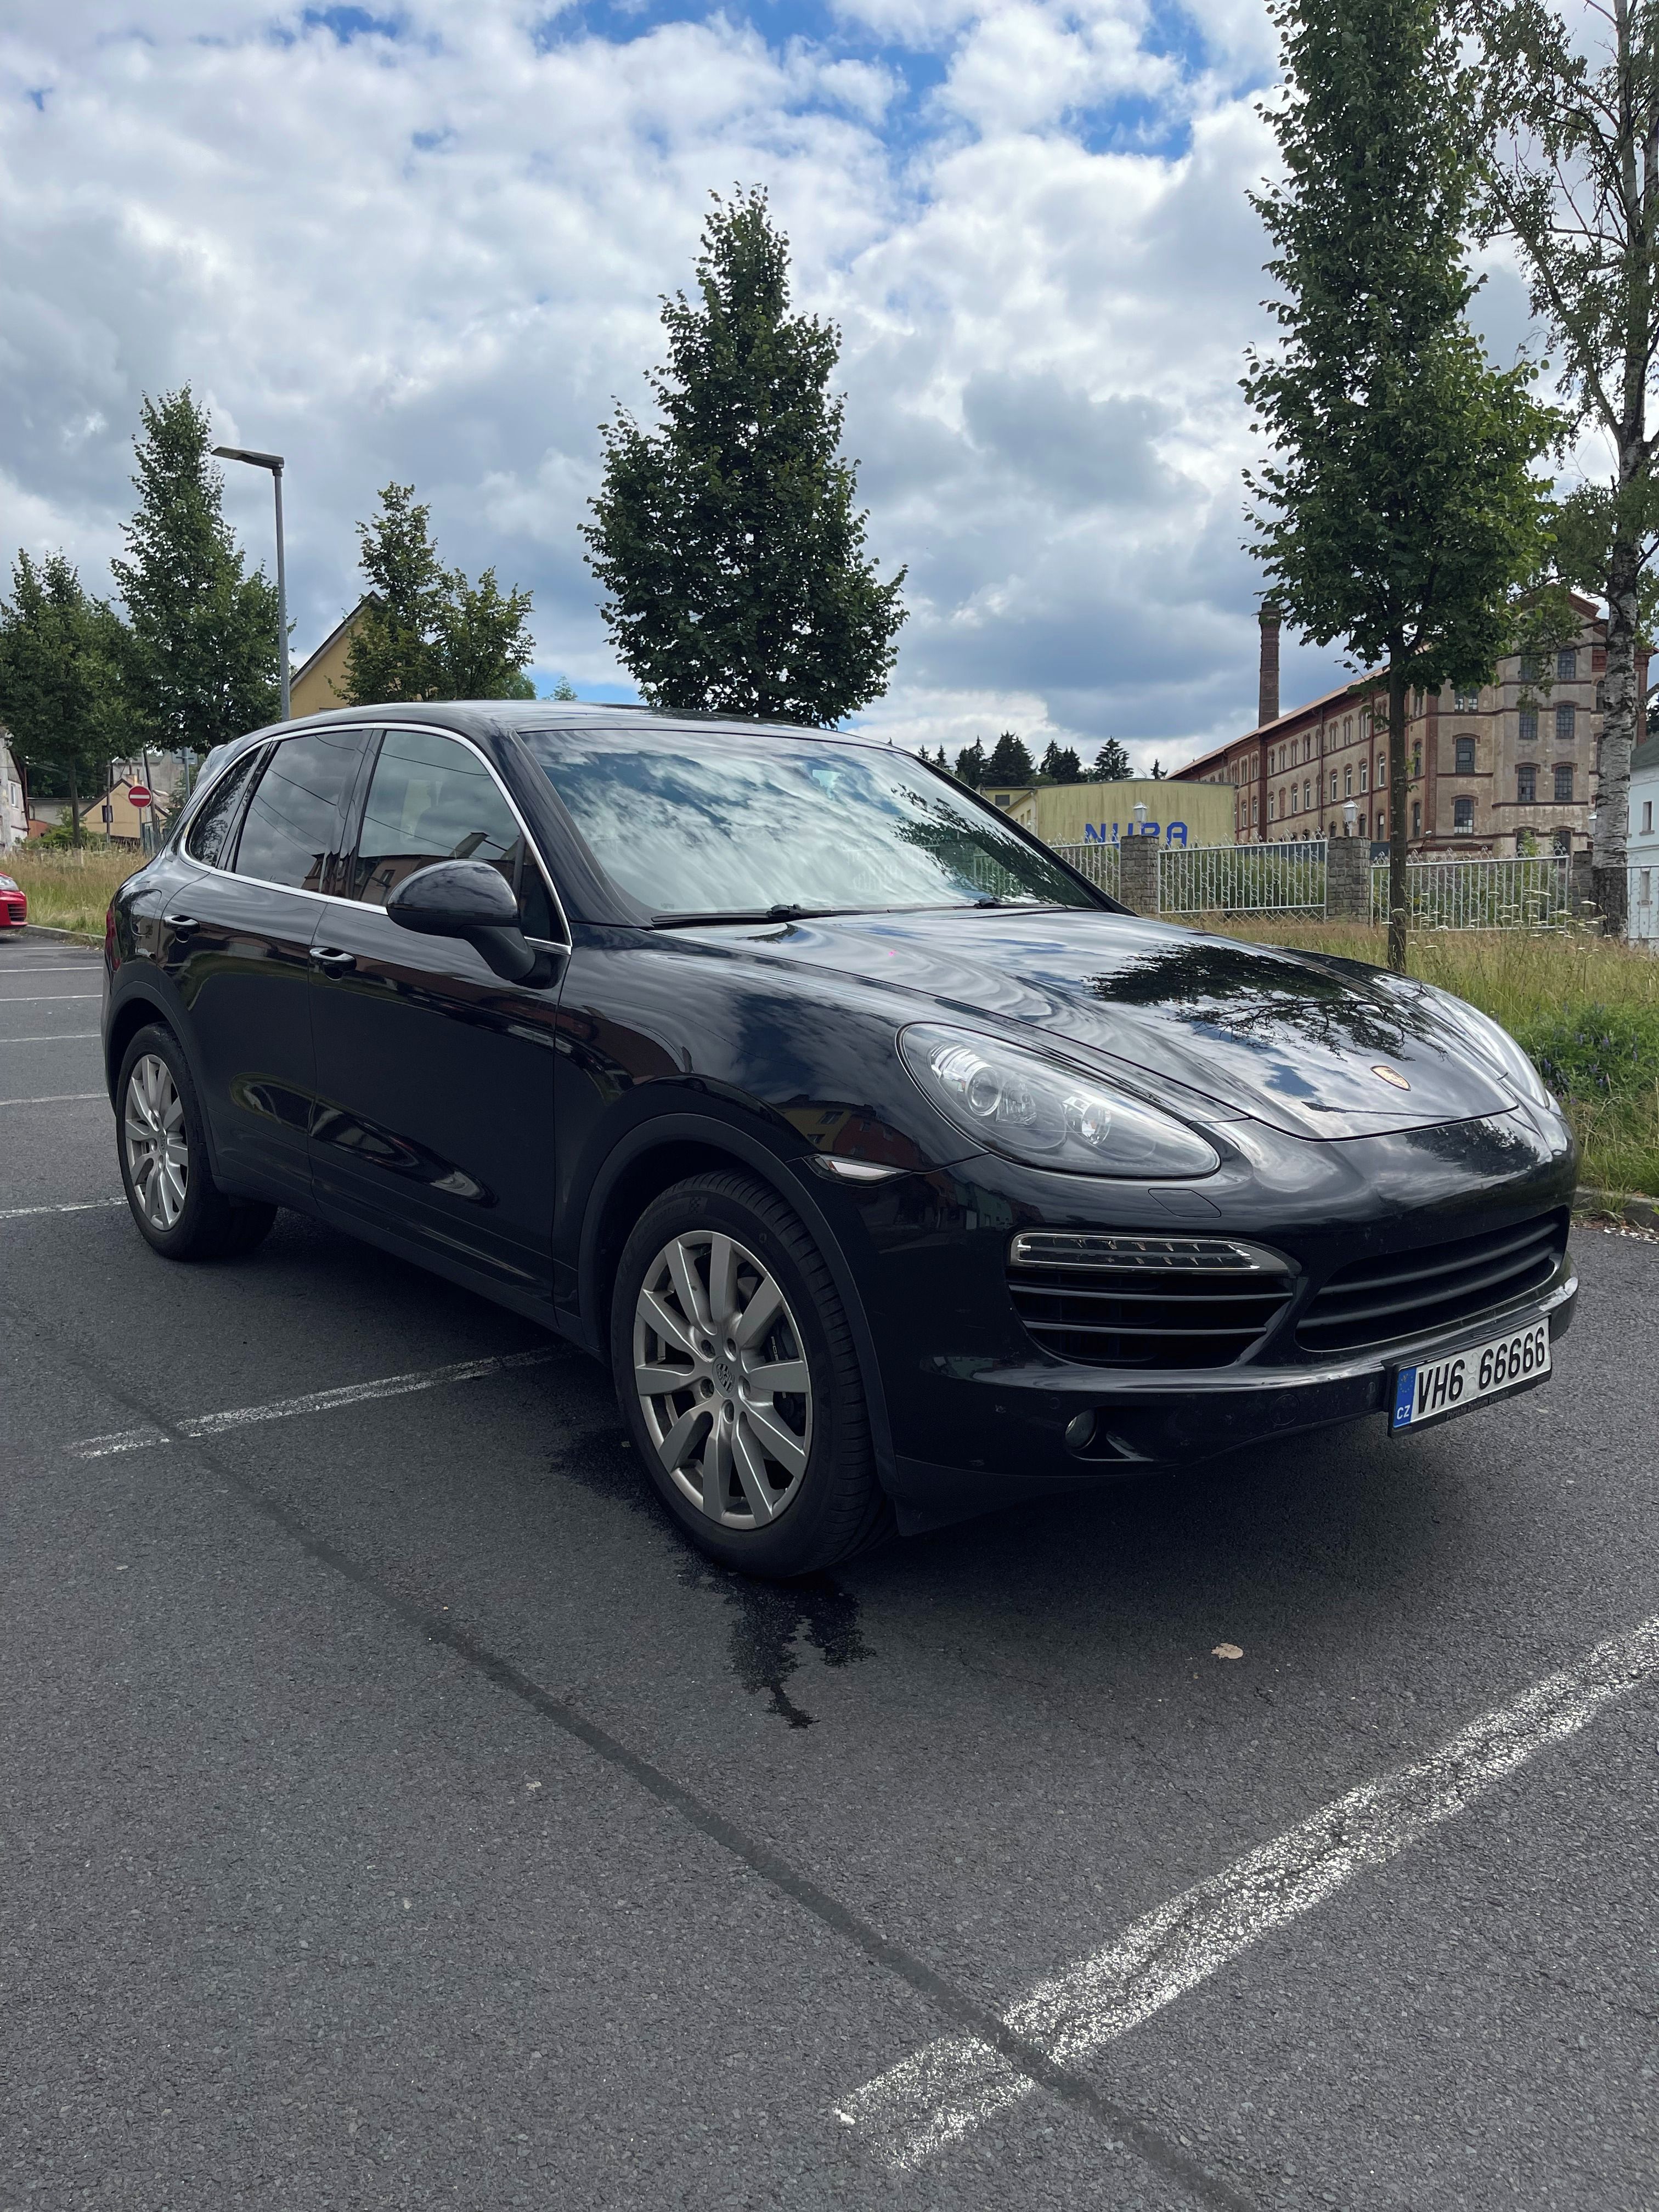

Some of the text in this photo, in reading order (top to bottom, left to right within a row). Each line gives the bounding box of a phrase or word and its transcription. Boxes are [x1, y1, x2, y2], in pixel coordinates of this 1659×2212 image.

[1418, 1327, 1544, 1414] VH6 66666
[1396, 1405, 1410, 1420] CZ
